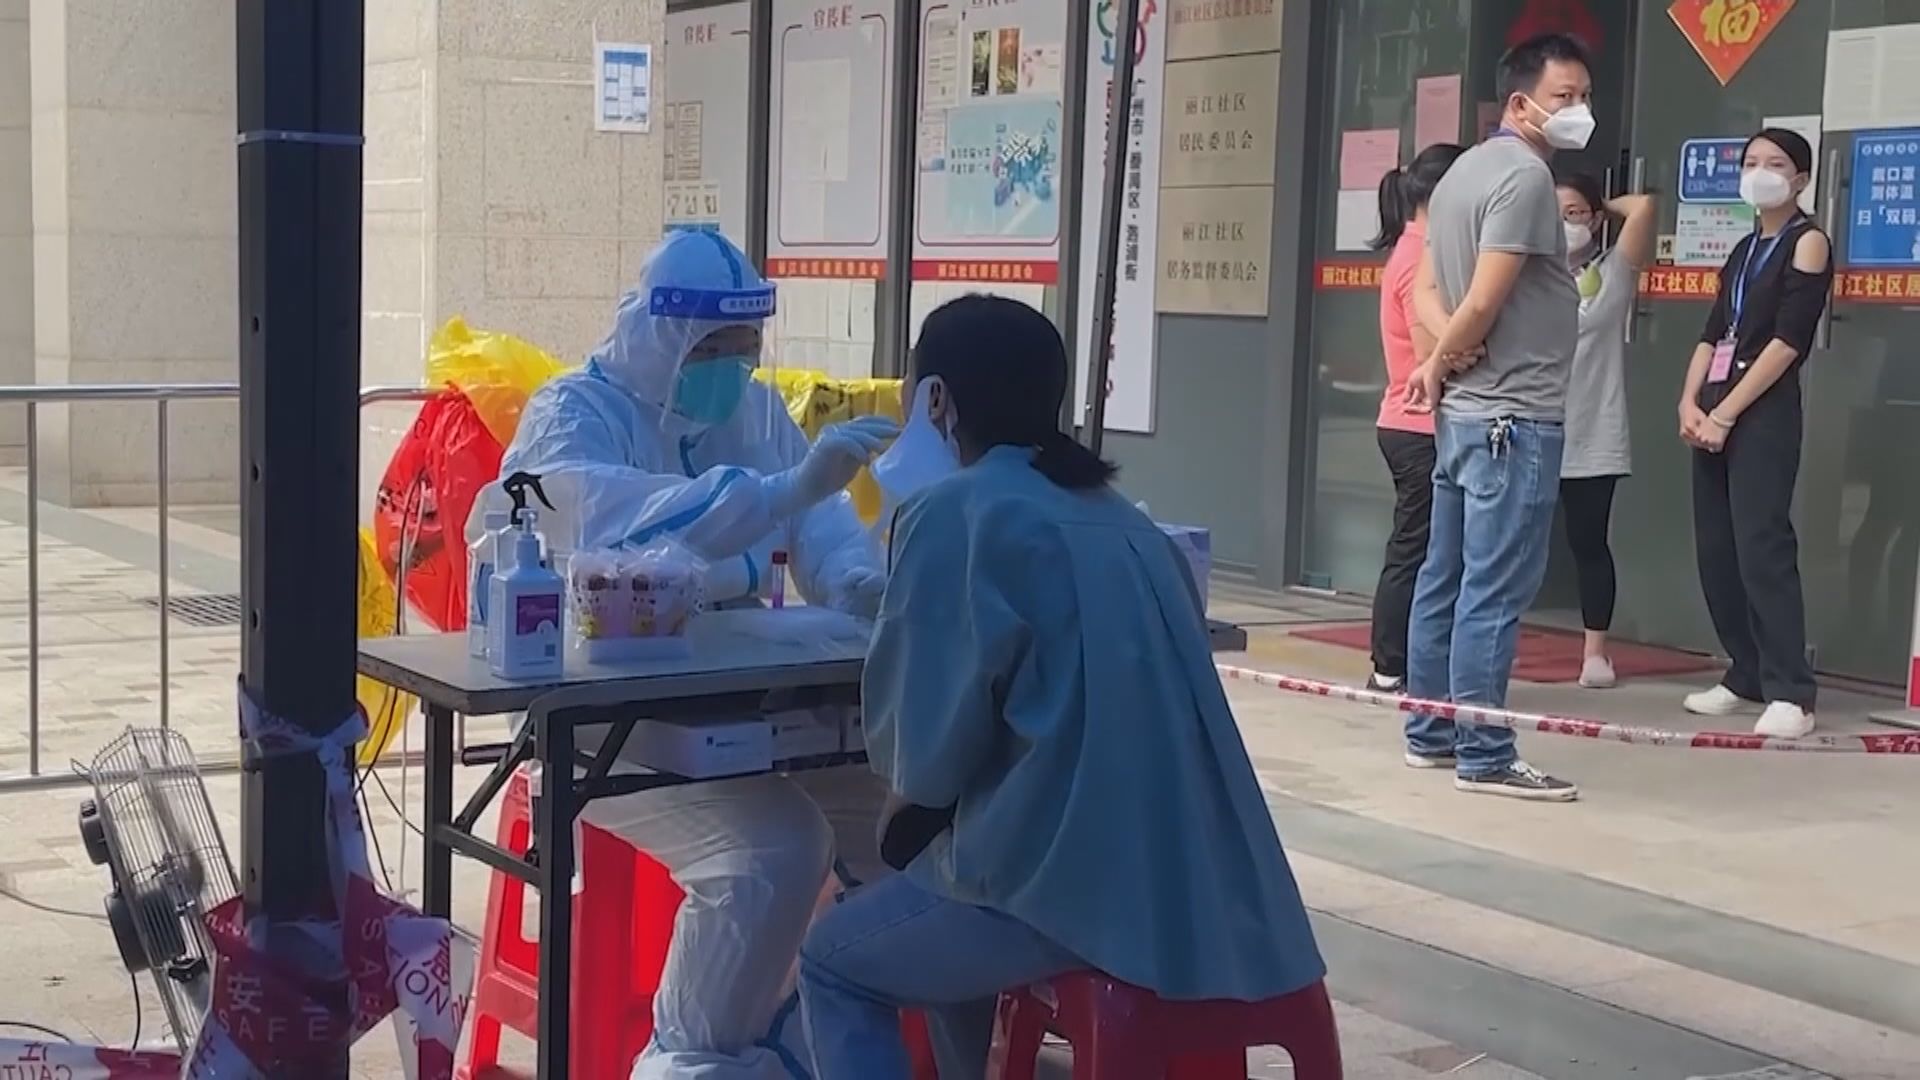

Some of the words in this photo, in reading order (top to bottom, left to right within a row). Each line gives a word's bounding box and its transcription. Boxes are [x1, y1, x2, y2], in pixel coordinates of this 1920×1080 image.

[1185, 93, 1246, 115] 丽江社区
[1179, 129, 1253, 152] 居民委员会
[1182, 221, 1244, 241] 丽江社区
[218, 1009, 330, 1043] SAFE
